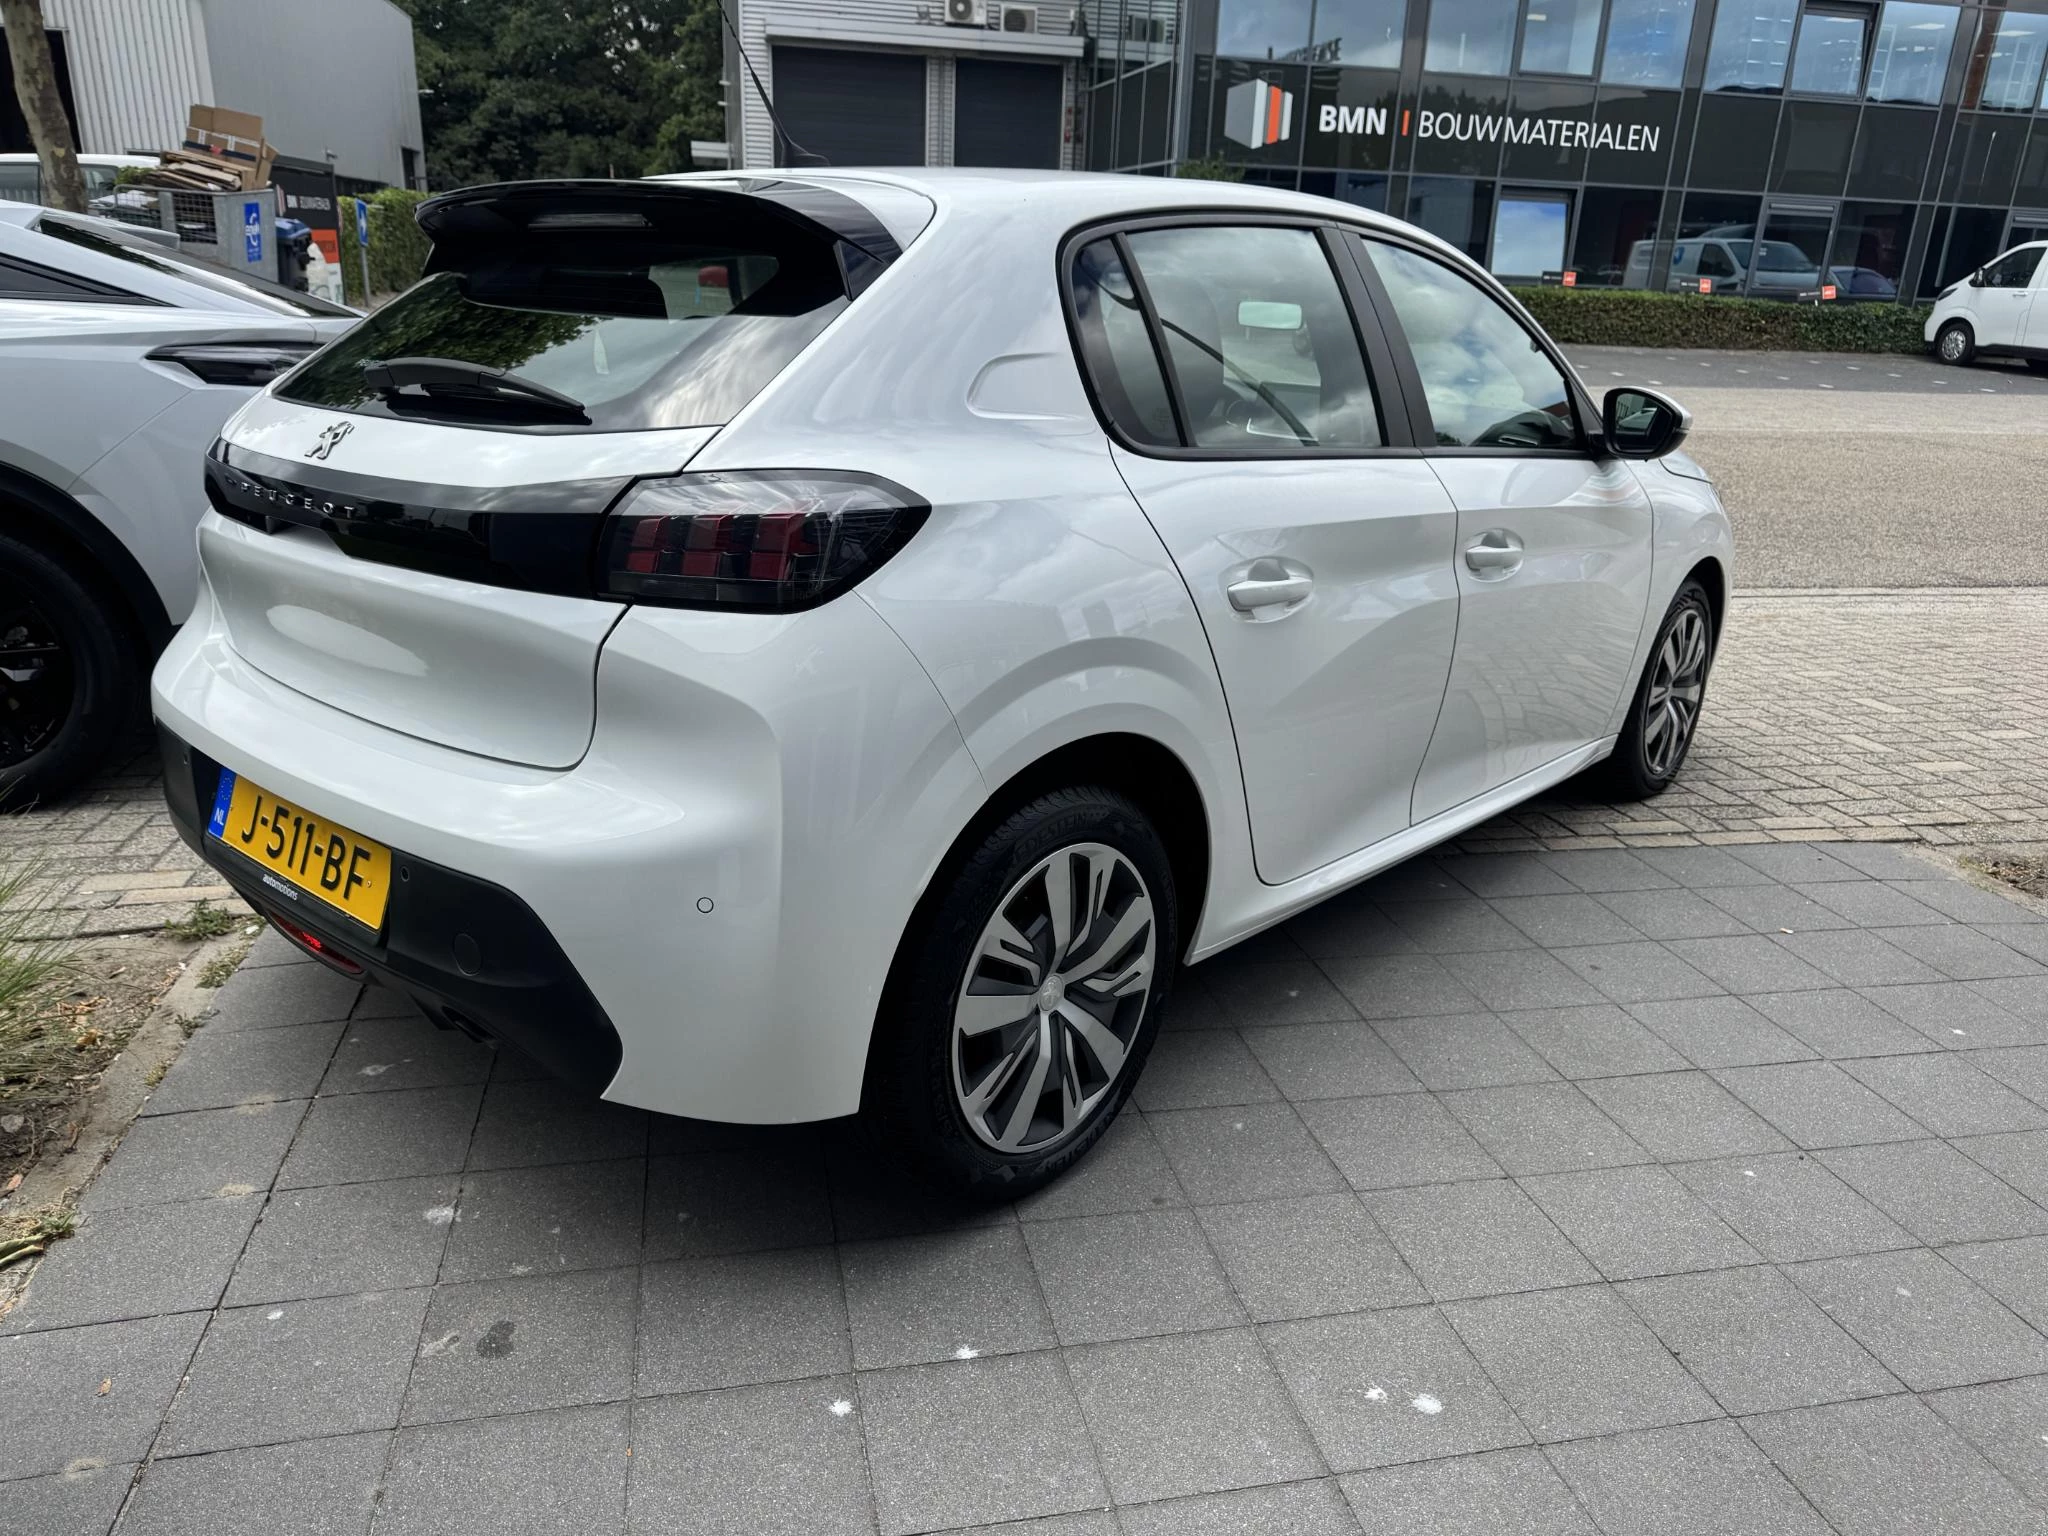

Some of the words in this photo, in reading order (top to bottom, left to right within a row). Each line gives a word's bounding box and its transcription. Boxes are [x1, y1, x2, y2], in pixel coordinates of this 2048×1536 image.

[1318, 103, 1387, 136] BMN
[1417, 110, 1660, 152] BOUWMATERIALEN
[240, 481, 355, 519] PEUGEOT
[214, 807, 225, 826] NL
[241, 795, 371, 900] J-511-BF
